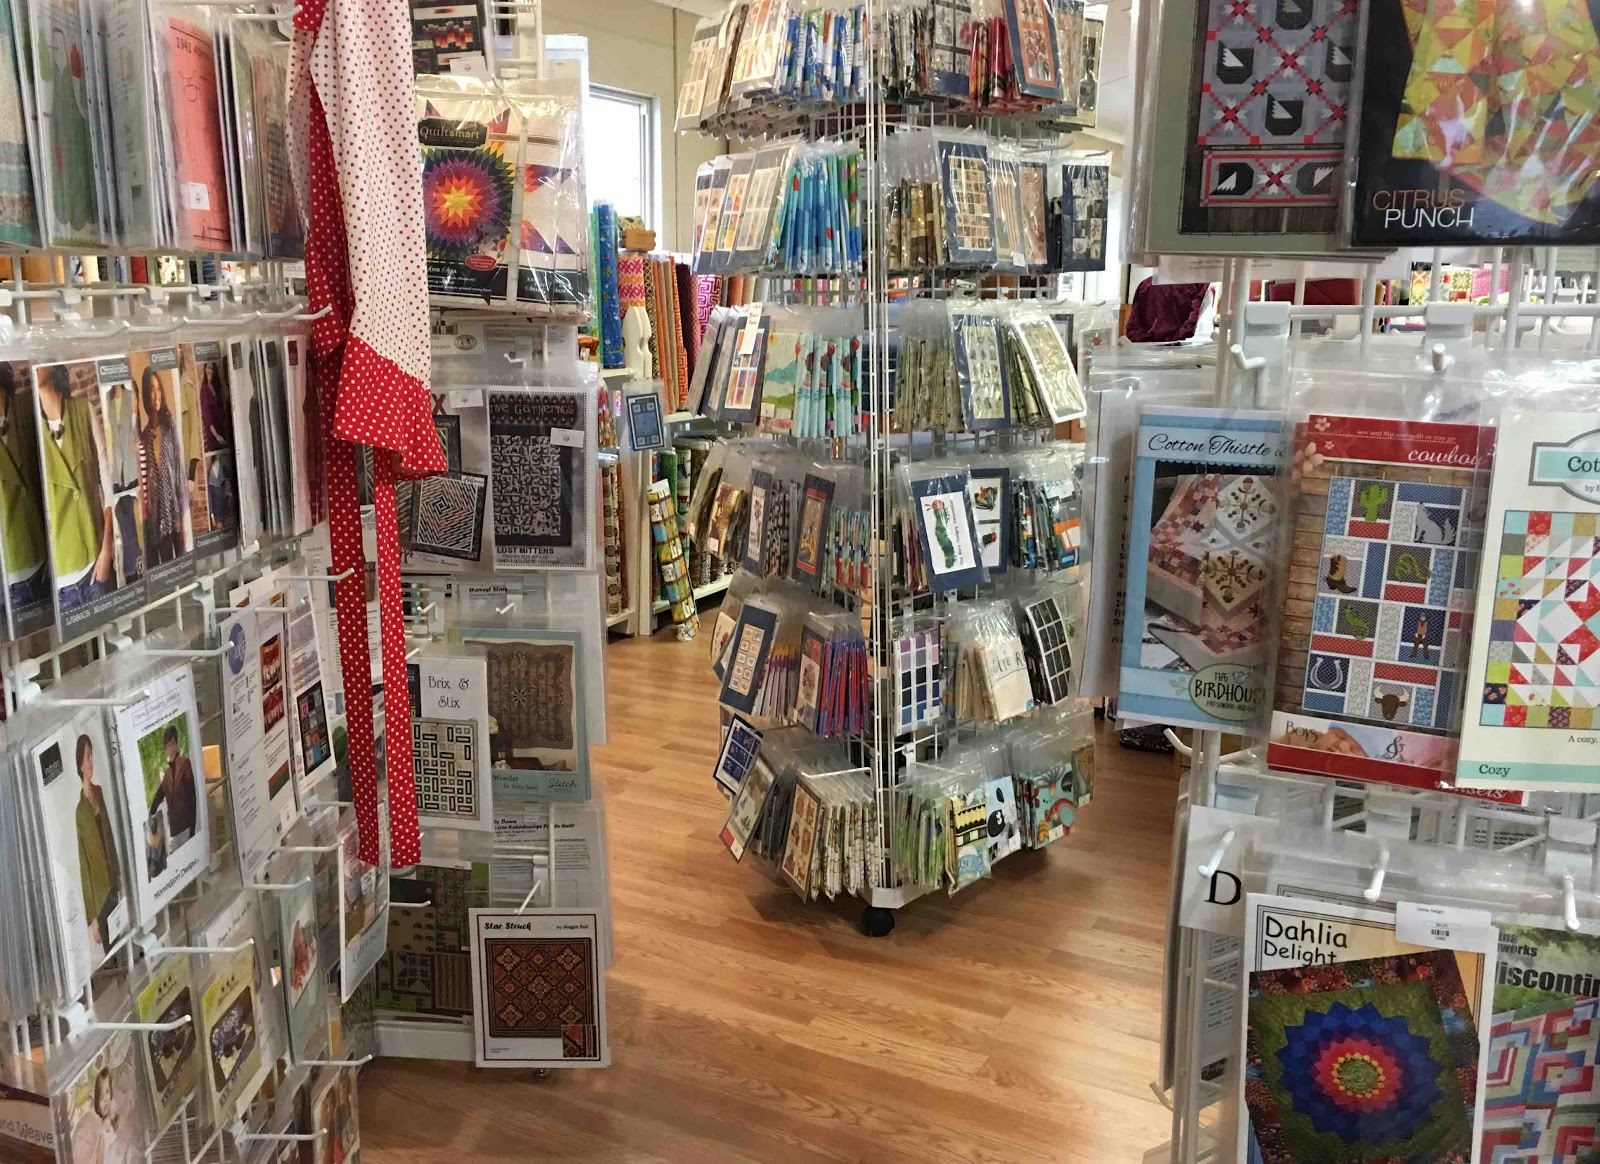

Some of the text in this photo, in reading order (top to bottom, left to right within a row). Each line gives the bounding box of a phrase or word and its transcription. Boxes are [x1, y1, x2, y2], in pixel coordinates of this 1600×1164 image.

[419, 125, 480, 139] Quiltsmart
[1372, 188, 1465, 210] CITRUS
[1384, 206, 1474, 228] PUNCH
[1148, 433, 1205, 451] Cotton
[1208, 435, 1271, 455] Thistle
[496, 547, 555, 555] LOST MITTENS
[428, 675, 470, 691] Brix &
[437, 695, 461, 709] Stix
[1479, 764, 1512, 777] Cozy
[1203, 869, 1242, 906] D
[484, 922, 532, 931] Star Struck
[1265, 915, 1348, 949] Dahlia
[1264, 939, 1337, 967] Delight
